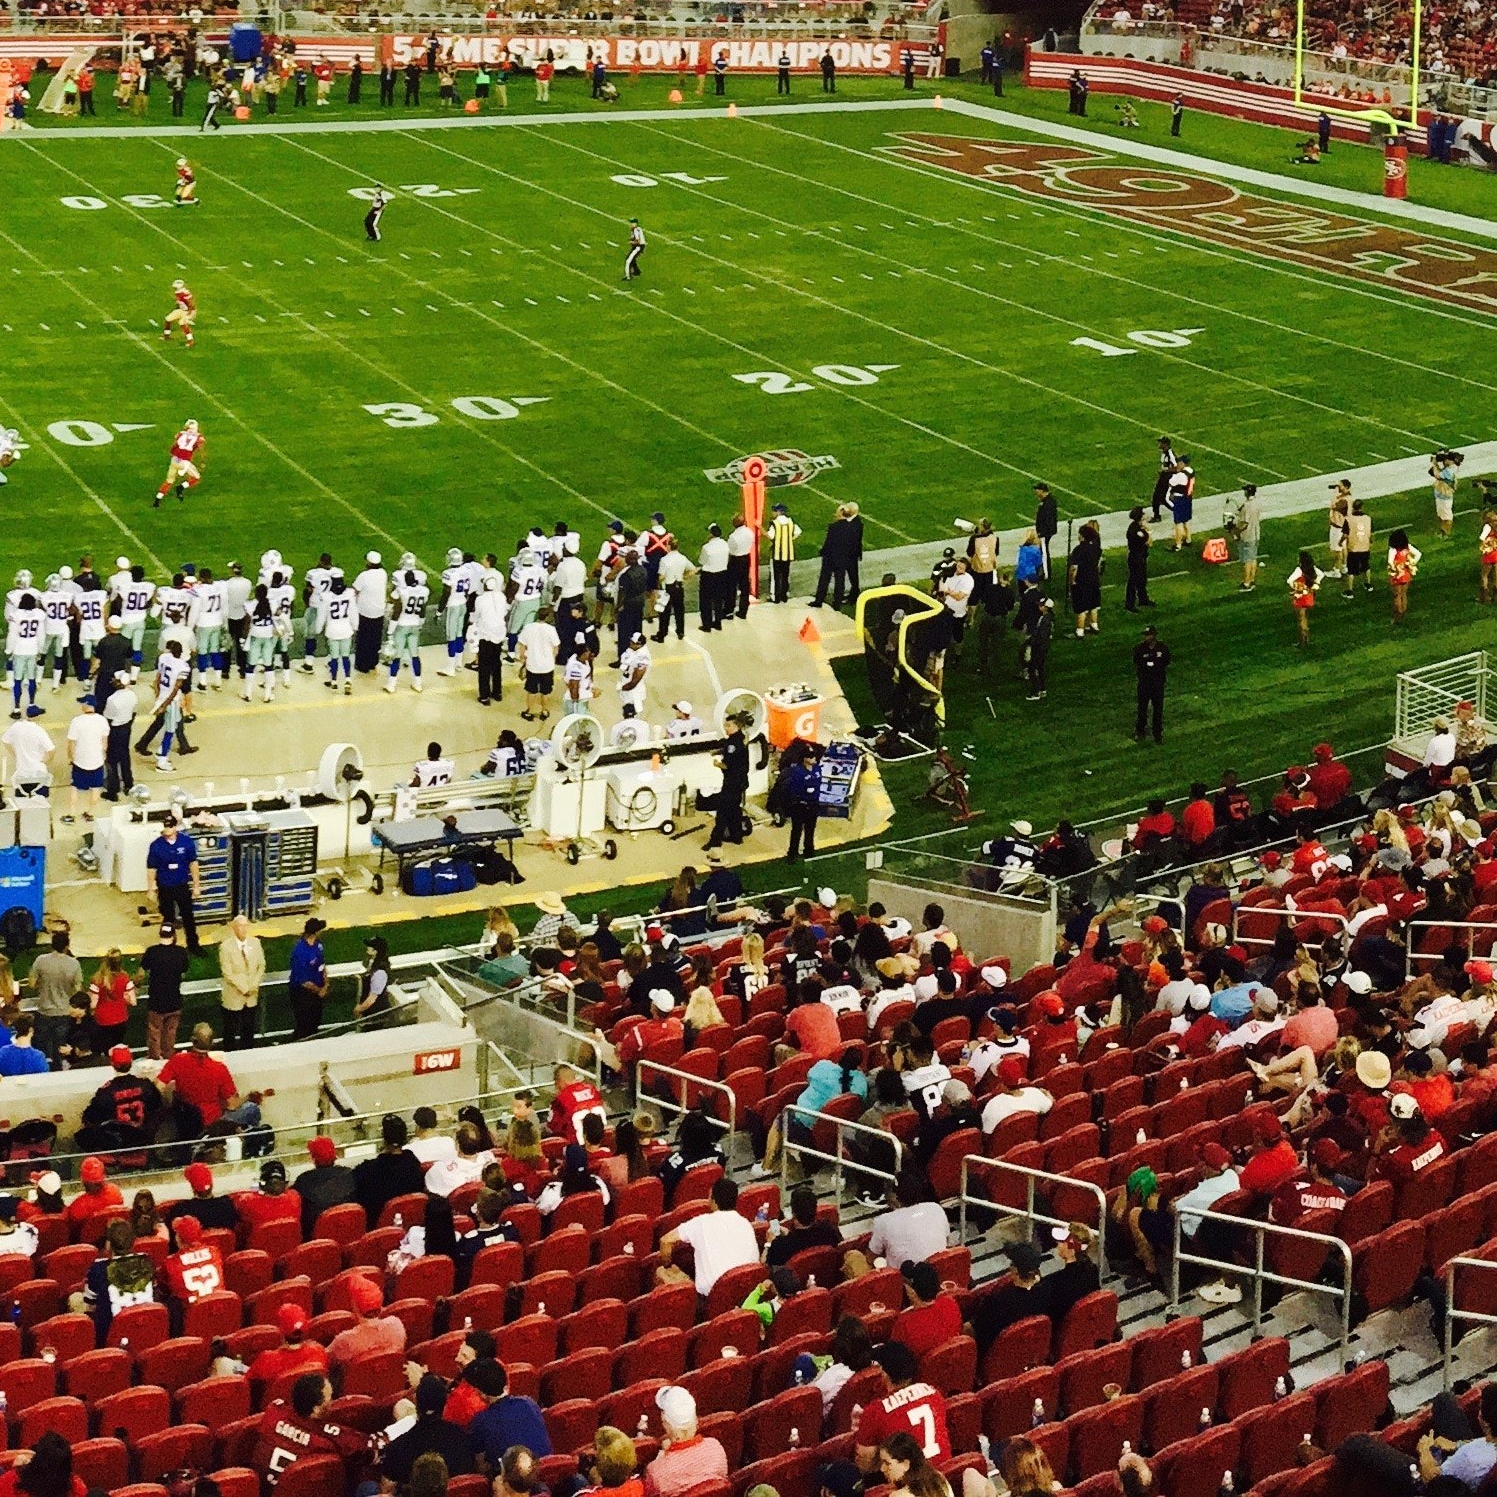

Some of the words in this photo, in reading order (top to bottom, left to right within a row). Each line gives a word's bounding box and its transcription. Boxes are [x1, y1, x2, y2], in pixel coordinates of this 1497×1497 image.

[1069, 329, 1192, 357] 10
[731, 364, 879, 395] 20
[361, 395, 521, 429] 30
[47, 601, 68, 620] 30
[81, 601, 102, 620] 26
[126, 591, 148, 611] 90
[329, 599, 349, 620] 27
[18, 619, 40, 639] 39
[794, 710, 816, 736] G
[181, 1264, 219, 1303] 52
[275, 1420, 311, 1445] GARCIA
[907, 1403, 940, 1459] 7
